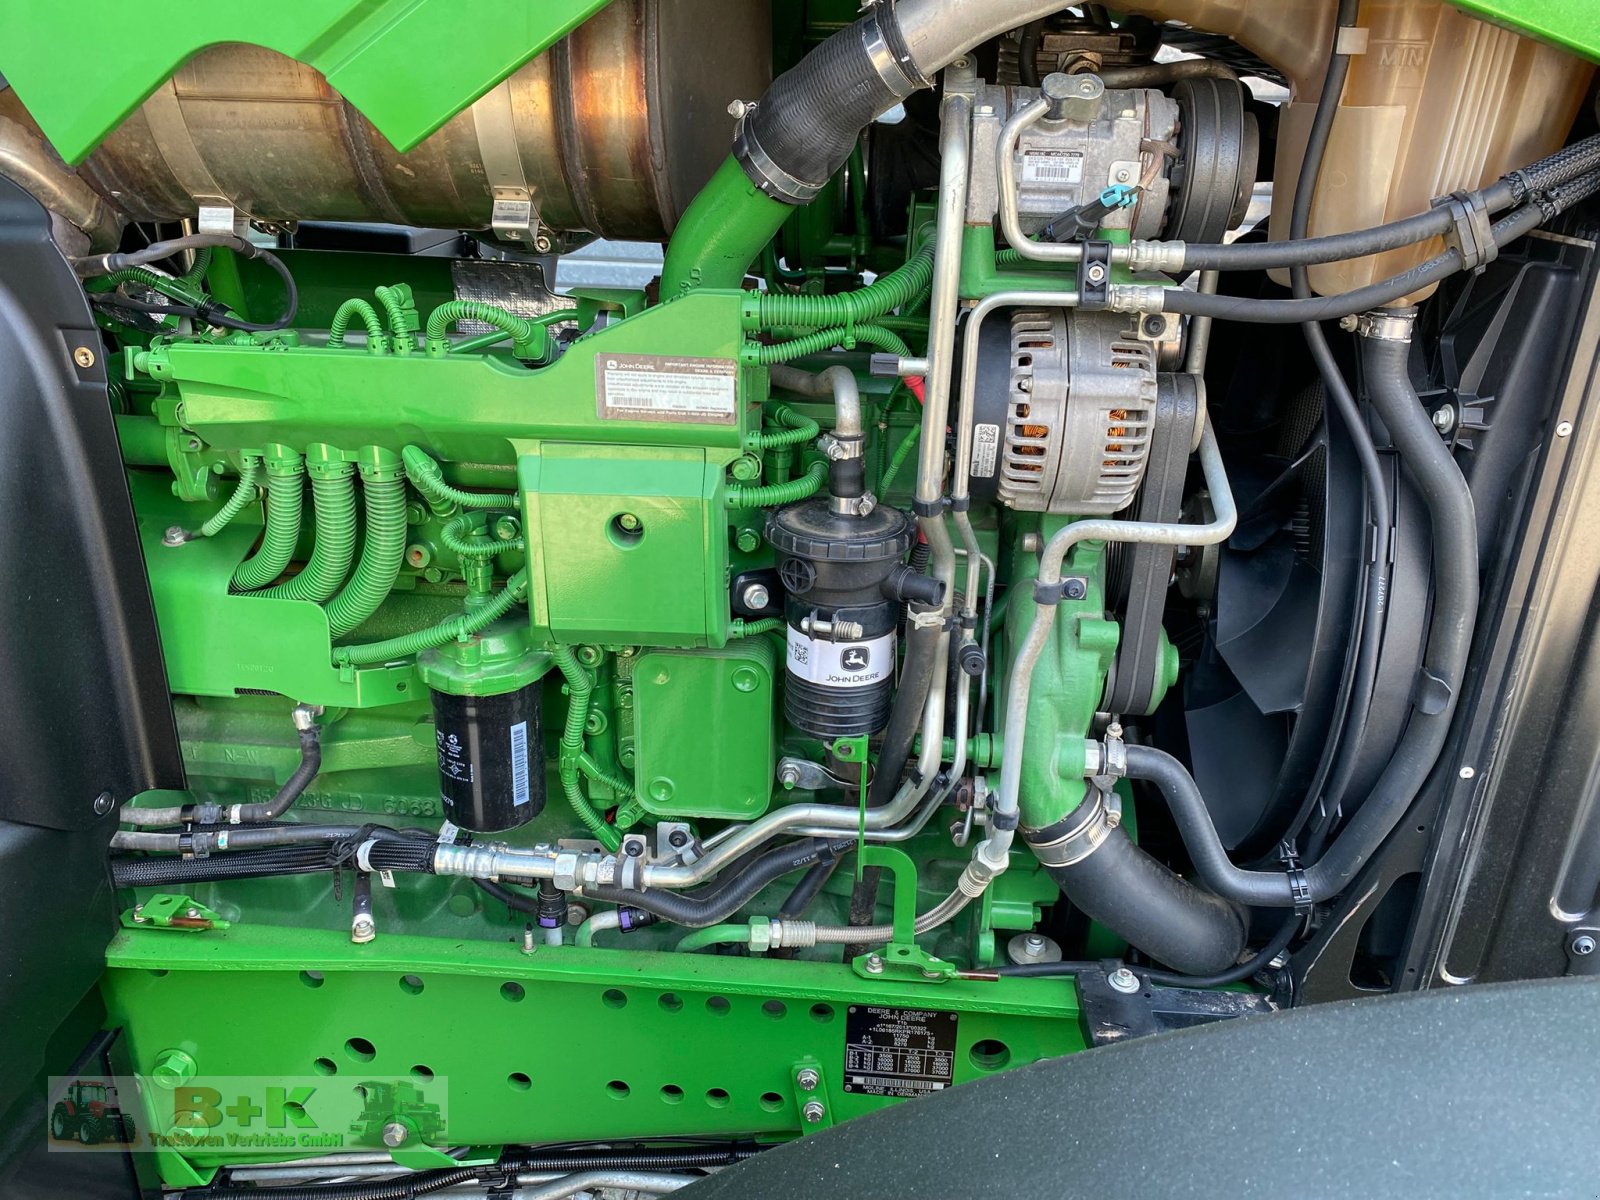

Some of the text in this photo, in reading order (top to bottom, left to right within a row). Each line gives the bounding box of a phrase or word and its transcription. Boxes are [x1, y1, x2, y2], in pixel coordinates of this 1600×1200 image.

[1380, 46, 1424, 66] MIN
[826, 672, 880, 682] JOHN DEERE
[384, 799, 436, 816] 6068
[868, 1008, 890, 1016] DEERE
